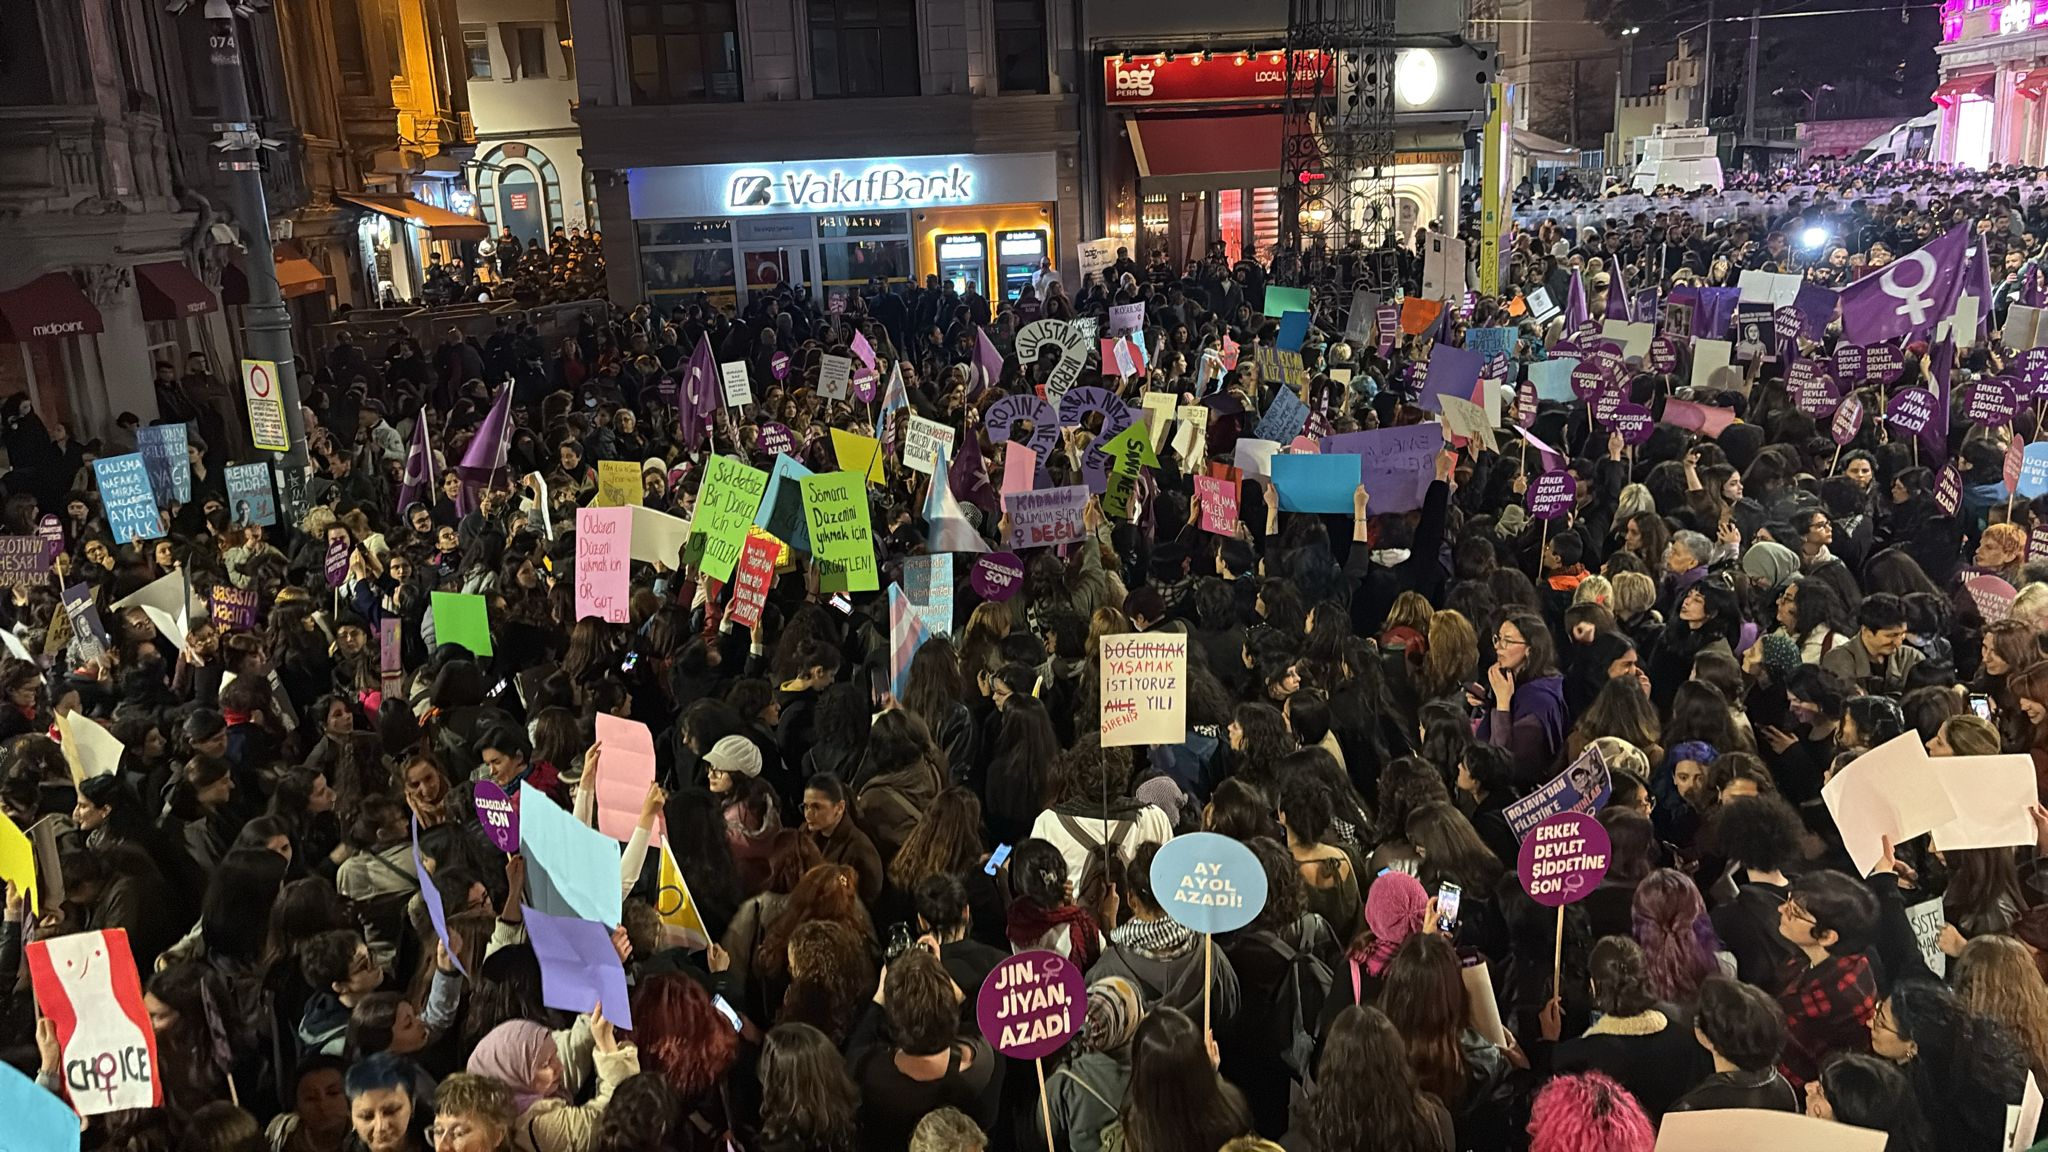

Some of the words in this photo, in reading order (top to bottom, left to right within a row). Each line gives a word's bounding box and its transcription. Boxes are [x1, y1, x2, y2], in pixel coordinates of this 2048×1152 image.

[209, 36, 235, 48] 074
[1255, 70, 1282, 82] LOCAL
[33, 320, 84, 337] midpoint
[1969, 411, 1988, 419] SON
[1619, 421, 1643, 431] SON
[1540, 476, 1564, 484] ERKEK
[1537, 485, 1564, 494] DEVLET
[1532, 503, 1550, 512] SON
[984, 570, 1012, 587] SON
[1104, 639, 1185, 659] DOĞURMAK
[1109, 660, 1173, 677] YAŞAMAK
[1106, 676, 1176, 691] İSTİYORUZ
[1146, 695, 1173, 711] YILI
[474, 796, 514, 814] CEZASIZLIĞA
[1506, 777, 1568, 823] ROJAVA'DAN
[486, 809, 510, 829] SON
[1535, 821, 1580, 842] ERKEK
[1533, 839, 1587, 860] DEVLET
[1193, 862, 1223, 876] AY
[1531, 853, 1607, 880] ŞİDDETİNE
[1179, 876, 1237, 893] AYOL
[1529, 879, 1562, 896] SON
[994, 960, 1040, 991] JIN,
